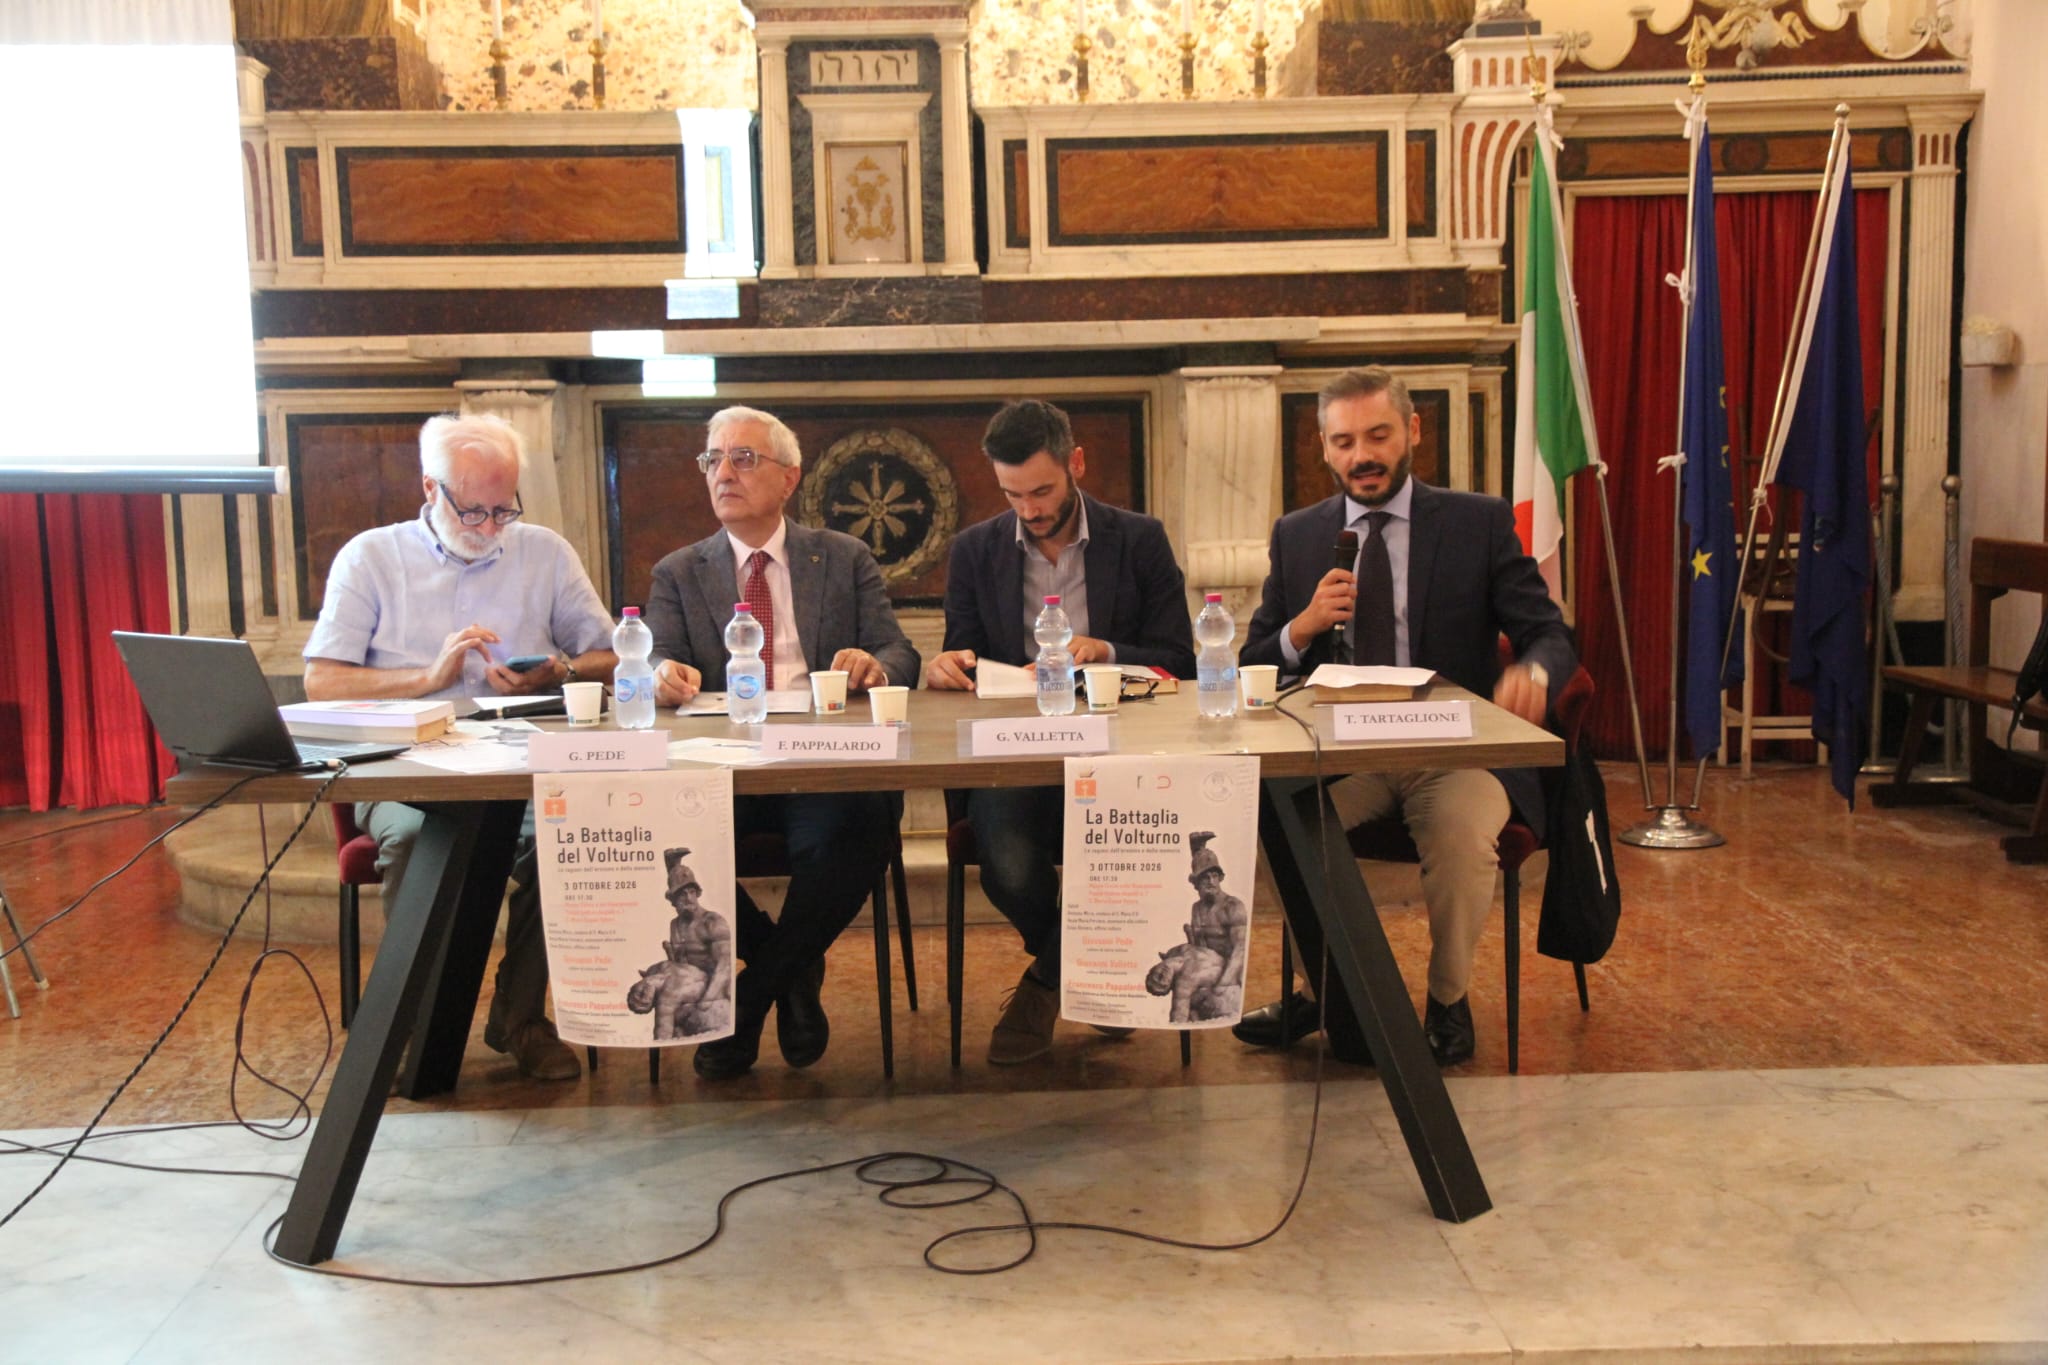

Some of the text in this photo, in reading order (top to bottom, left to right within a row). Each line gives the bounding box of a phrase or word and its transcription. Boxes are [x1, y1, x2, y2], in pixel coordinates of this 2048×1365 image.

[818, 53, 910, 83] יהוה
[1344, 712, 1460, 725] T. TARTAGLIONE
[996, 731, 1084, 743] G. VALLETTA
[778, 740, 881, 752] F. PAPPALARDO
[568, 751, 626, 762] G. PEDE
[1086, 808, 1179, 828] La Battaglia
[557, 826, 652, 846] La Battaglia
[1085, 829, 1181, 845] del Volturno
[557, 846, 655, 864] del Volturno
[1089, 863, 1162, 872] 3 OTTOBRE 2026
[564, 881, 637, 891] 3 OTTOBRE 2026
